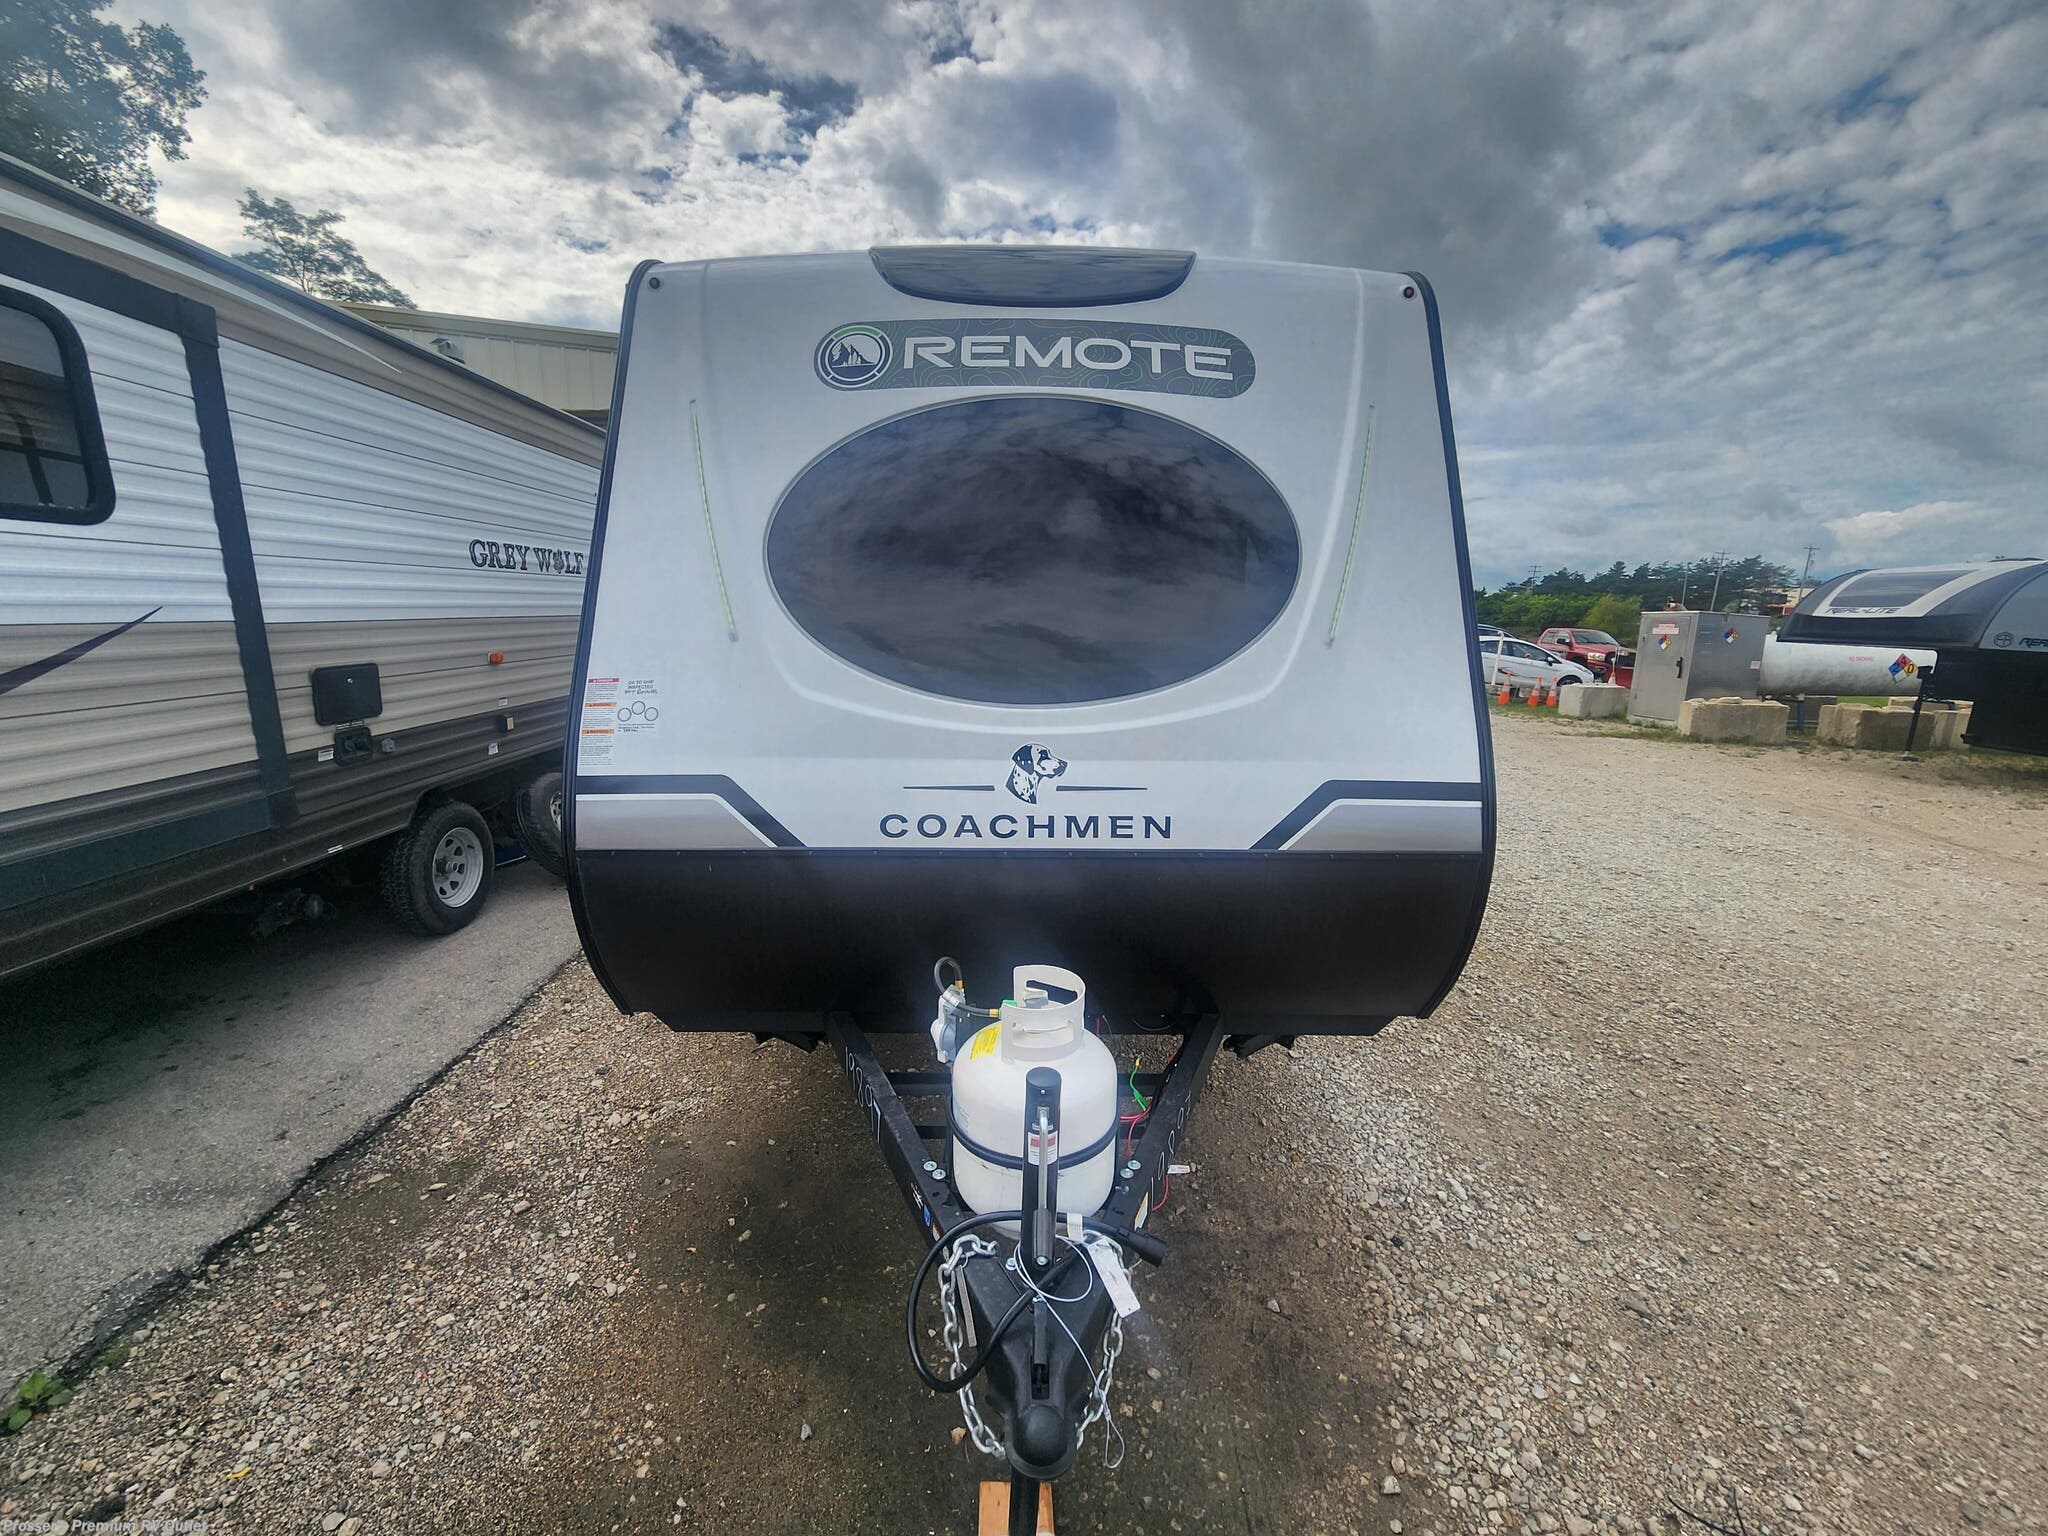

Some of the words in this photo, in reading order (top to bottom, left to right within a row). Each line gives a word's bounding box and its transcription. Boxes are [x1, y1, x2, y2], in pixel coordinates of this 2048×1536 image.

[903, 335, 1234, 381] REMOTE
[469, 538, 530, 571] GREY
[879, 813, 1172, 839] COACHMEN
